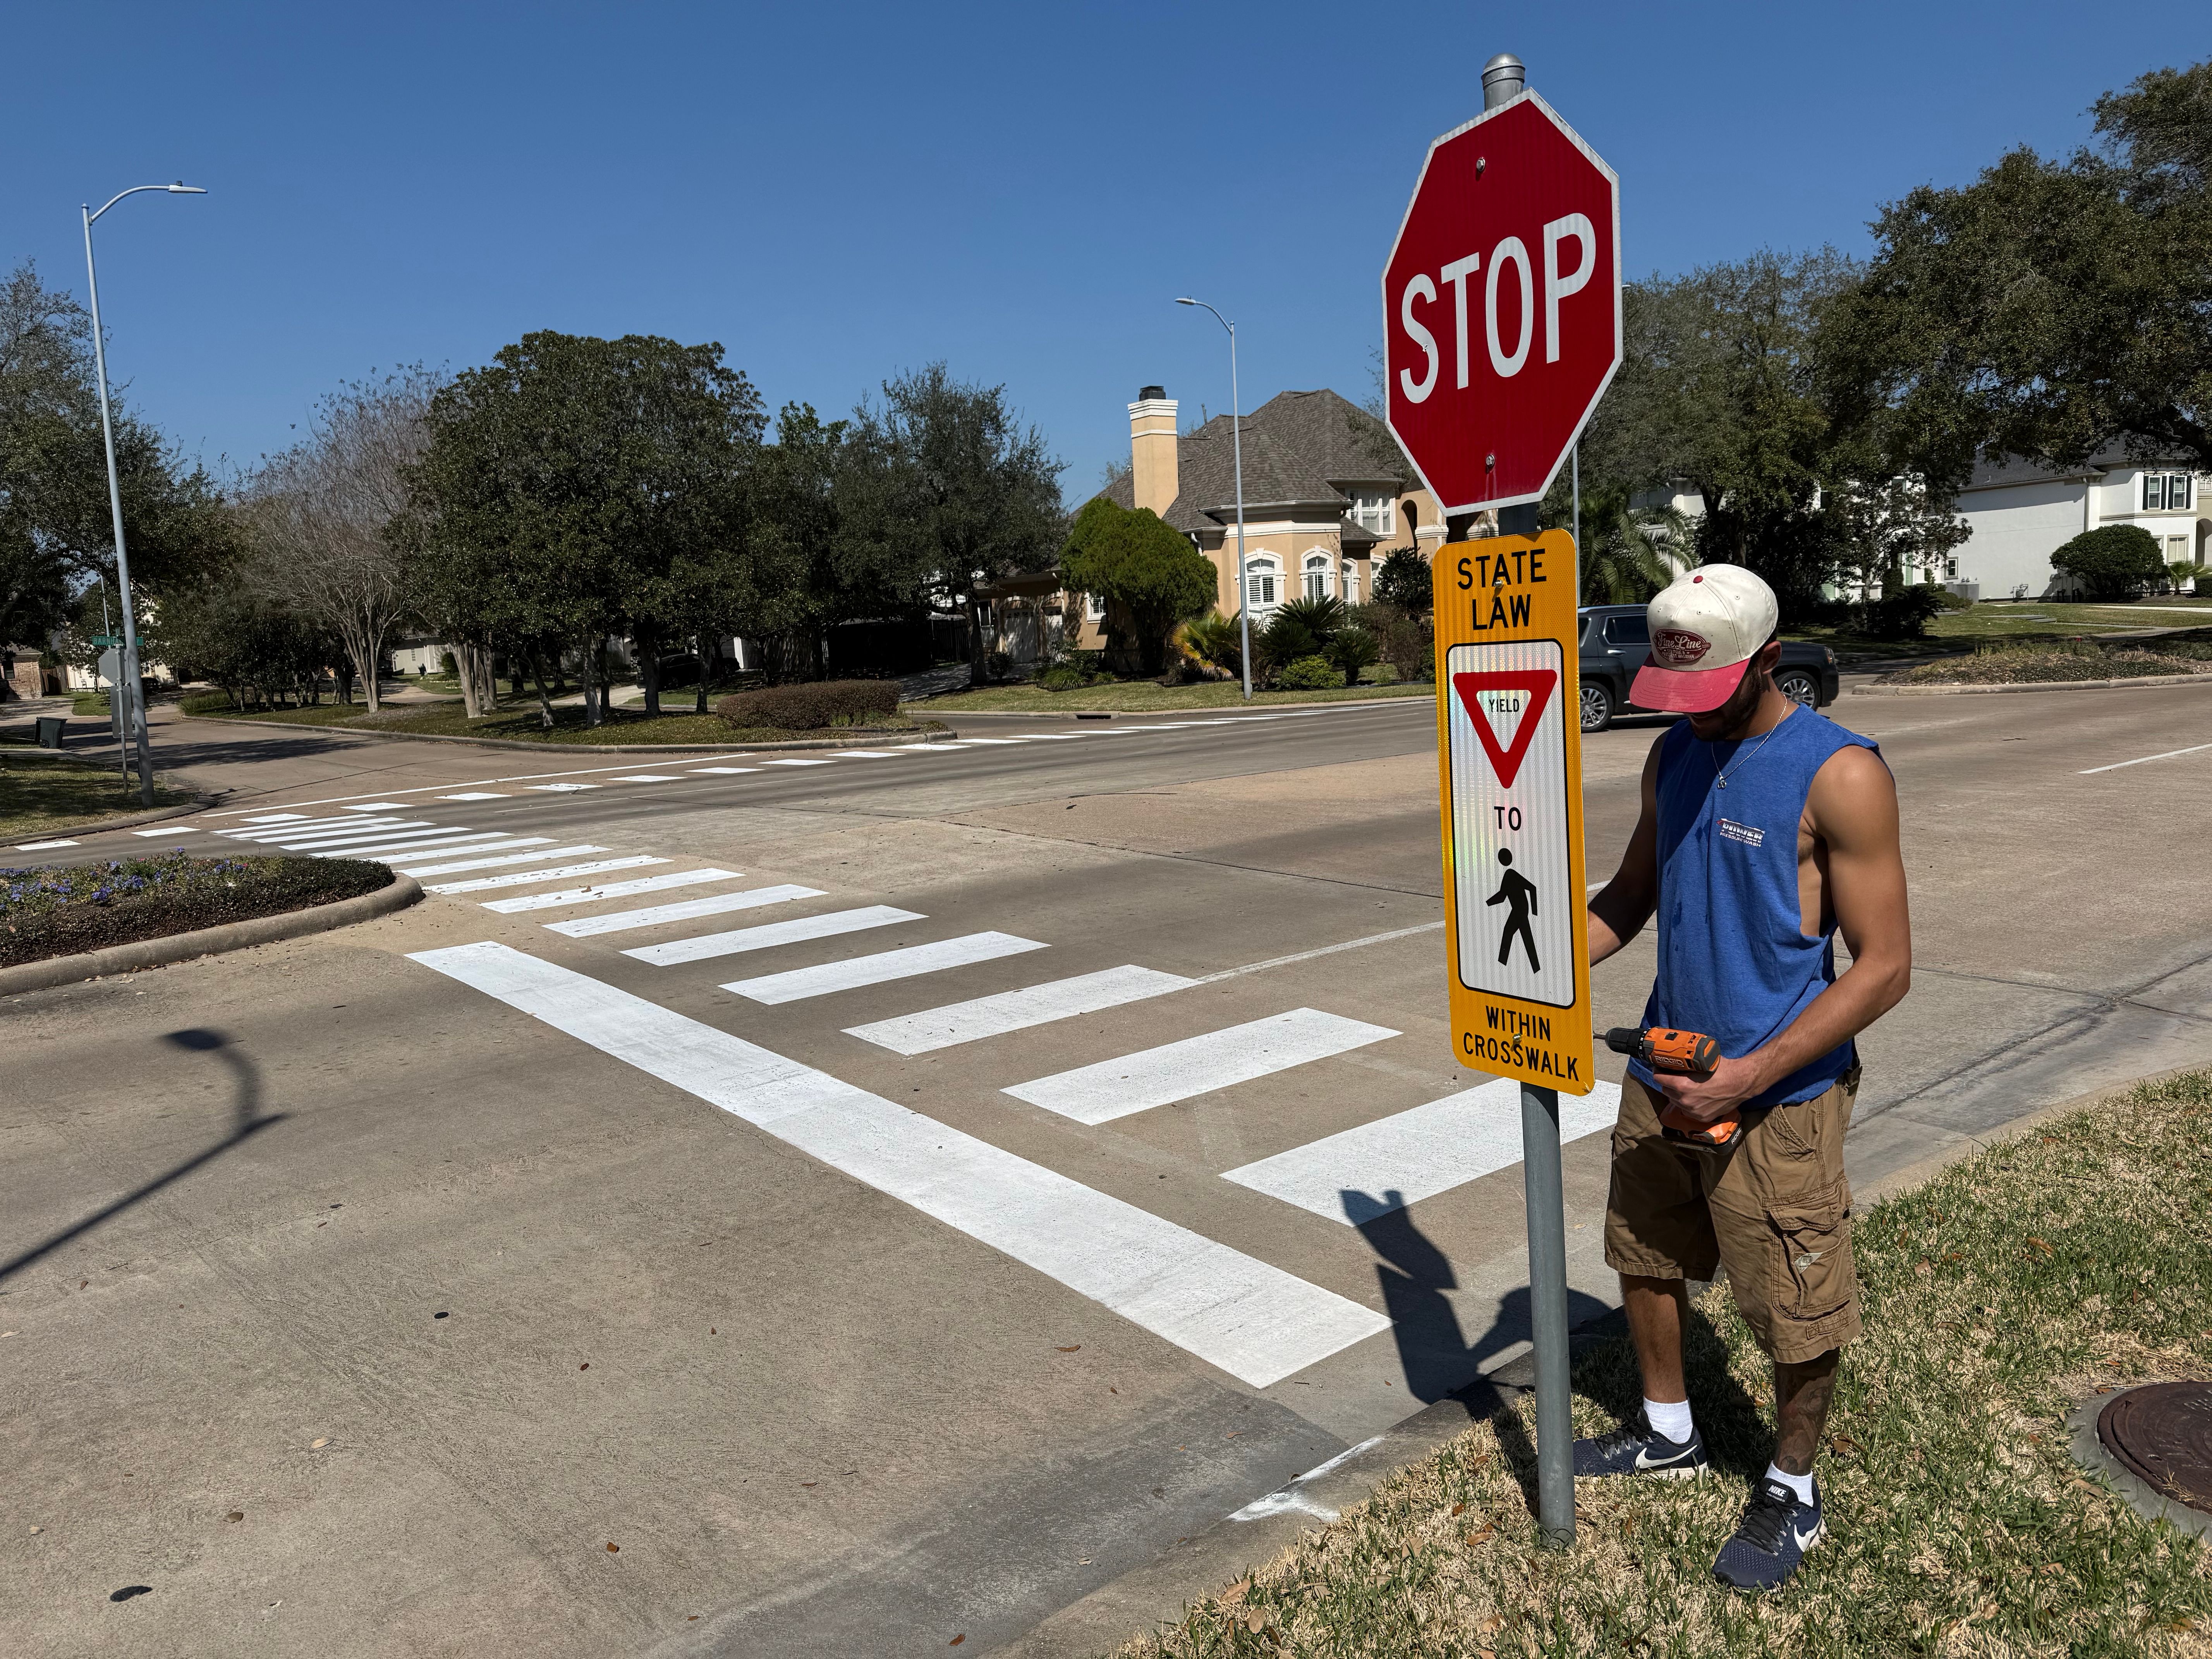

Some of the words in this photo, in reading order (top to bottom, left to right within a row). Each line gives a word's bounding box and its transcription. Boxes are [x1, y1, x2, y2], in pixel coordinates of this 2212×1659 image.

[1401, 213, 1595, 403] STOP
[1458, 549, 1546, 589] STATE
[1472, 594, 1530, 630] LAW
[1658, 632, 1675, 647] Fine
[1675, 636, 1701, 650] Line
[1489, 699, 1519, 712] YIELD
[1494, 806, 1521, 831] TO
[1720, 832, 1743, 842] PRESSURE
[1743, 839, 1761, 847] WASH
[1721, 823, 1763, 843] POWER
[1486, 1006, 1550, 1041] WITHIN
[1464, 1032, 1578, 1081] CROSSWALK
[1654, 1056, 1683, 1065] RIDGID
[1768, 1485, 1786, 1497] NIKE
